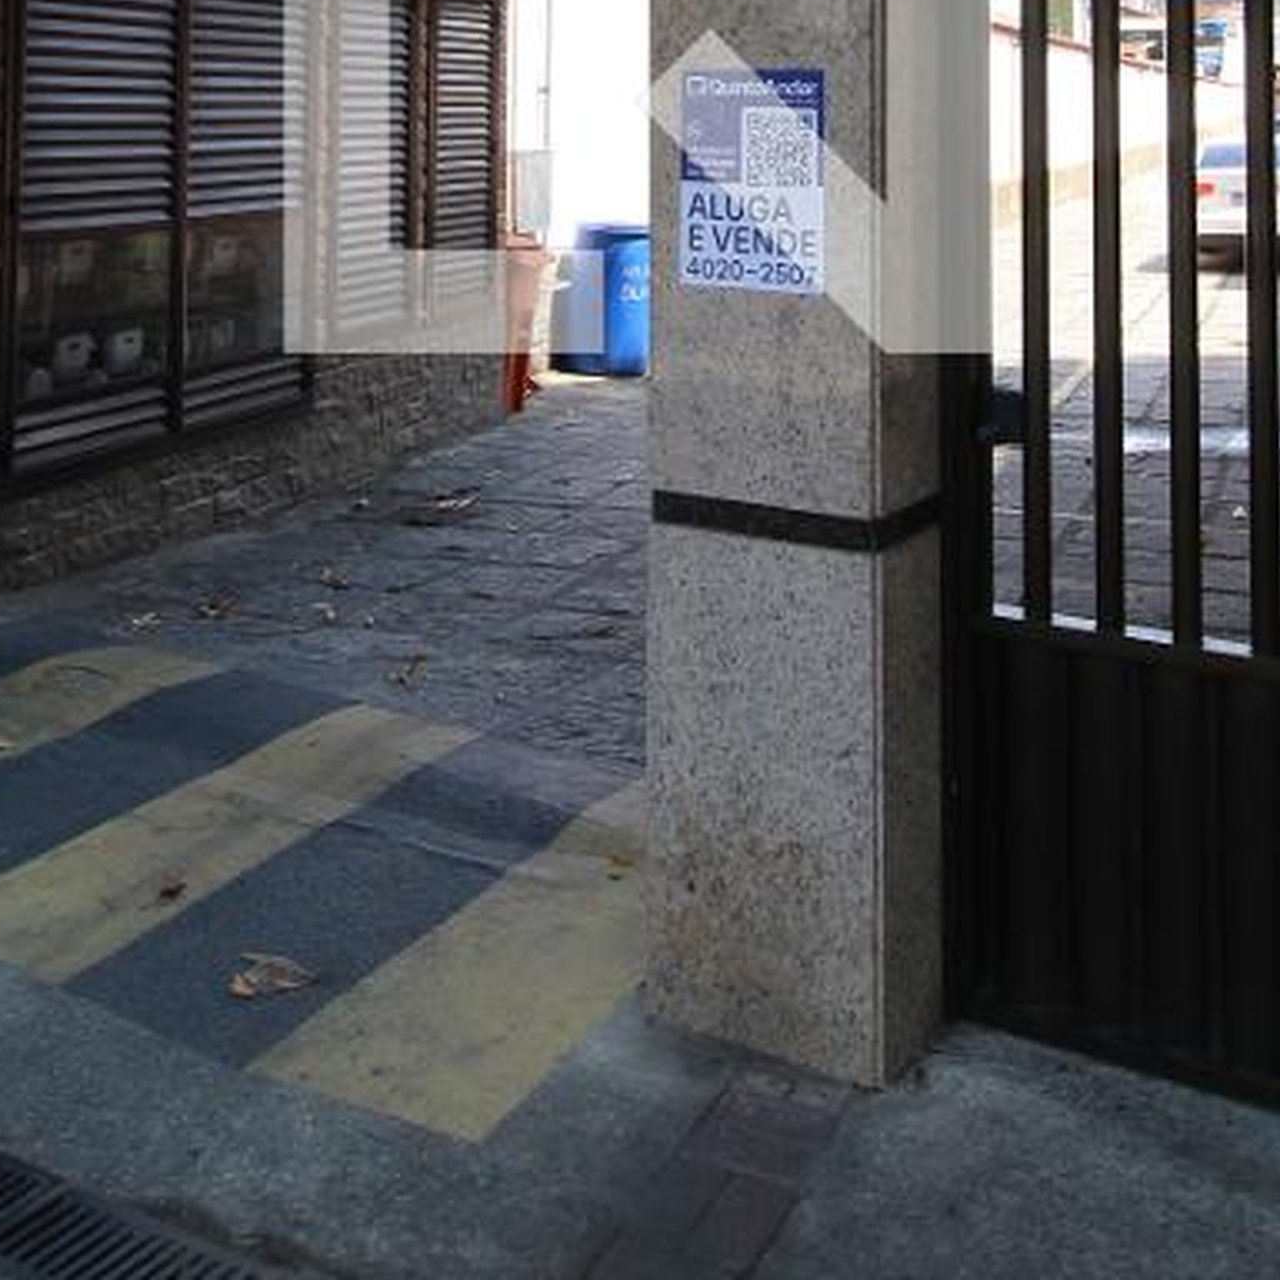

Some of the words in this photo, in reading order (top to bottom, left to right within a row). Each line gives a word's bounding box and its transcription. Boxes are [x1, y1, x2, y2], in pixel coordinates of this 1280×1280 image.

[688, 193, 791, 221] ALUGA
[689, 224, 703, 252] E
[713, 225, 818, 257] VENDE
